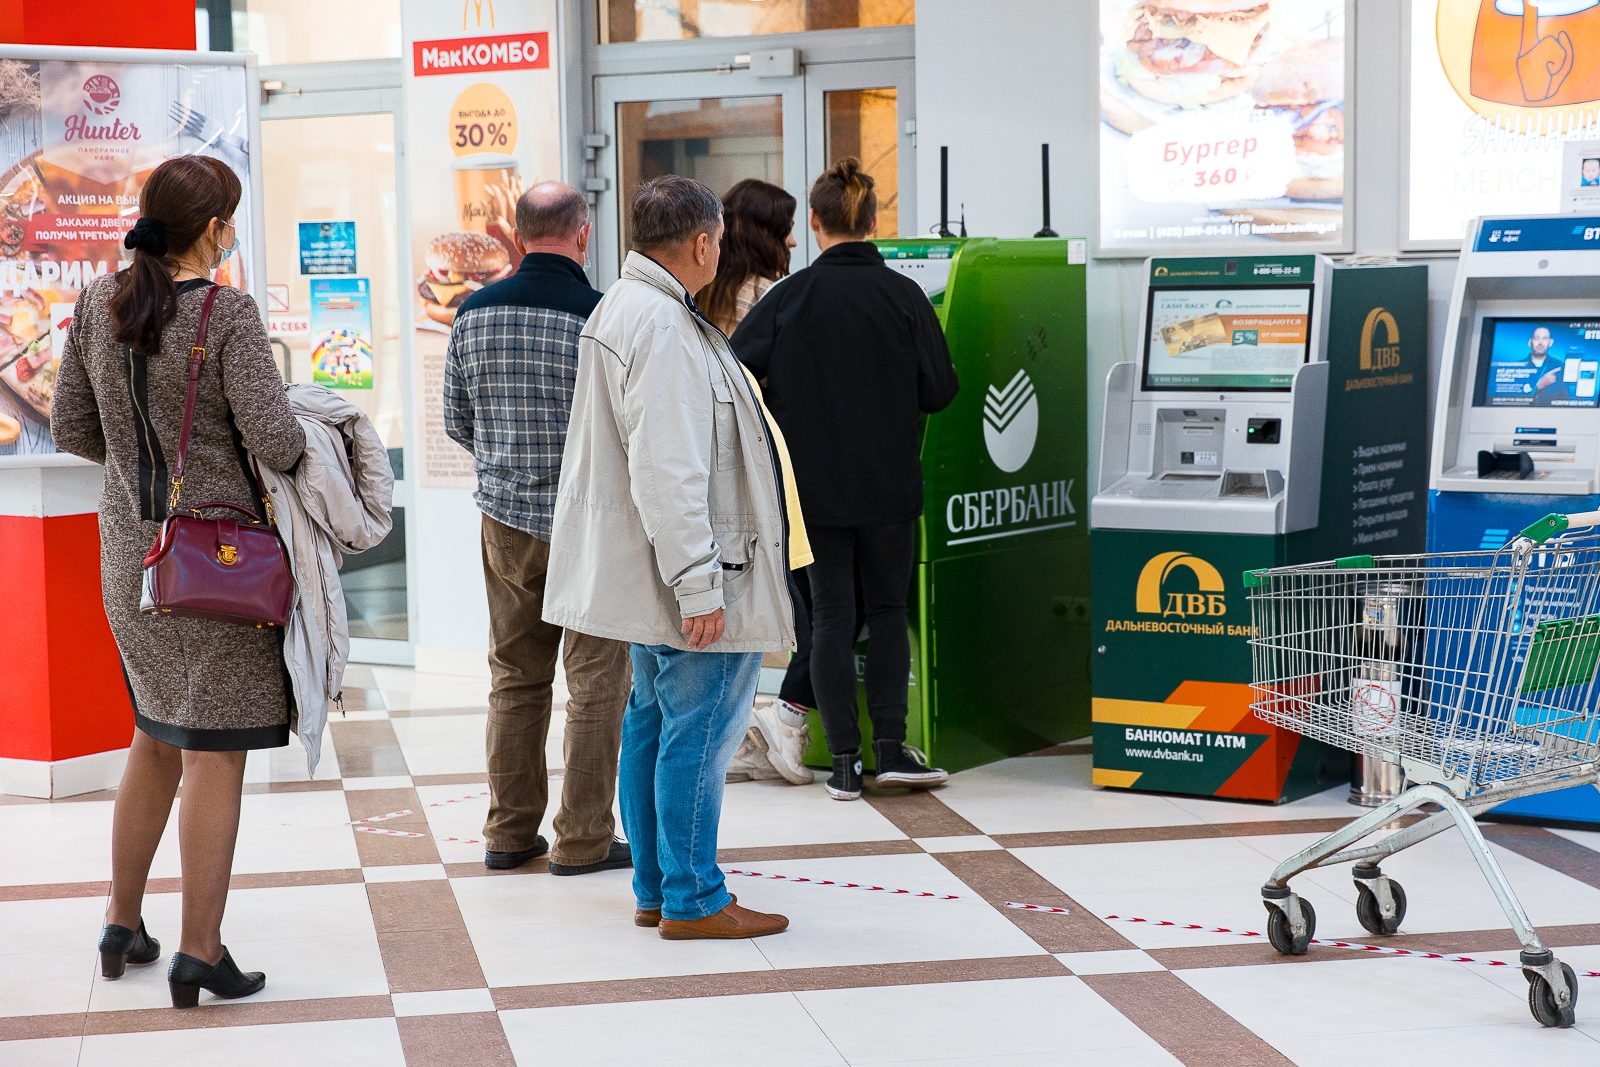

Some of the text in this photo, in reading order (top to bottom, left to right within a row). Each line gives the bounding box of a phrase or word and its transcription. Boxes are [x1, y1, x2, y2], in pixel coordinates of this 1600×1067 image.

[421, 40, 540, 69] МакКОМБО
[64, 114, 142, 142] Hunter
[1163, 136, 1258, 165] Бургер
[1193, 166, 1238, 189] 360
[57, 194, 140, 206] АКЦИЯ НА ВЫН
[56, 217, 138, 229] ЗАКАЖИ ДВЕ ПИ
[35, 230, 78, 241] ПОЛУЧИ
[79, 230, 119, 240] ТРЕТЬЮ
[1583, 227, 1600, 240] ВТ
[281, 322, 307, 331] СЕБЯ
[1232, 318, 1301, 327] ВОЗВРАЩАЮТСЯ
[1234, 331, 1257, 344] 5%
[1372, 346, 1400, 371] ДВБ
[946, 478, 1077, 533] СБЕРБАНК
[1163, 593, 1227, 619] ДВБ
[1105, 620, 1224, 636] ДАЛЬНЕВОСТОЧНЫЙ
[1125, 728, 1203, 746] БАНКОМАТ
[1214, 735, 1246, 749] ATM
[1125, 747, 1204, 762] www.dvbank.ru
